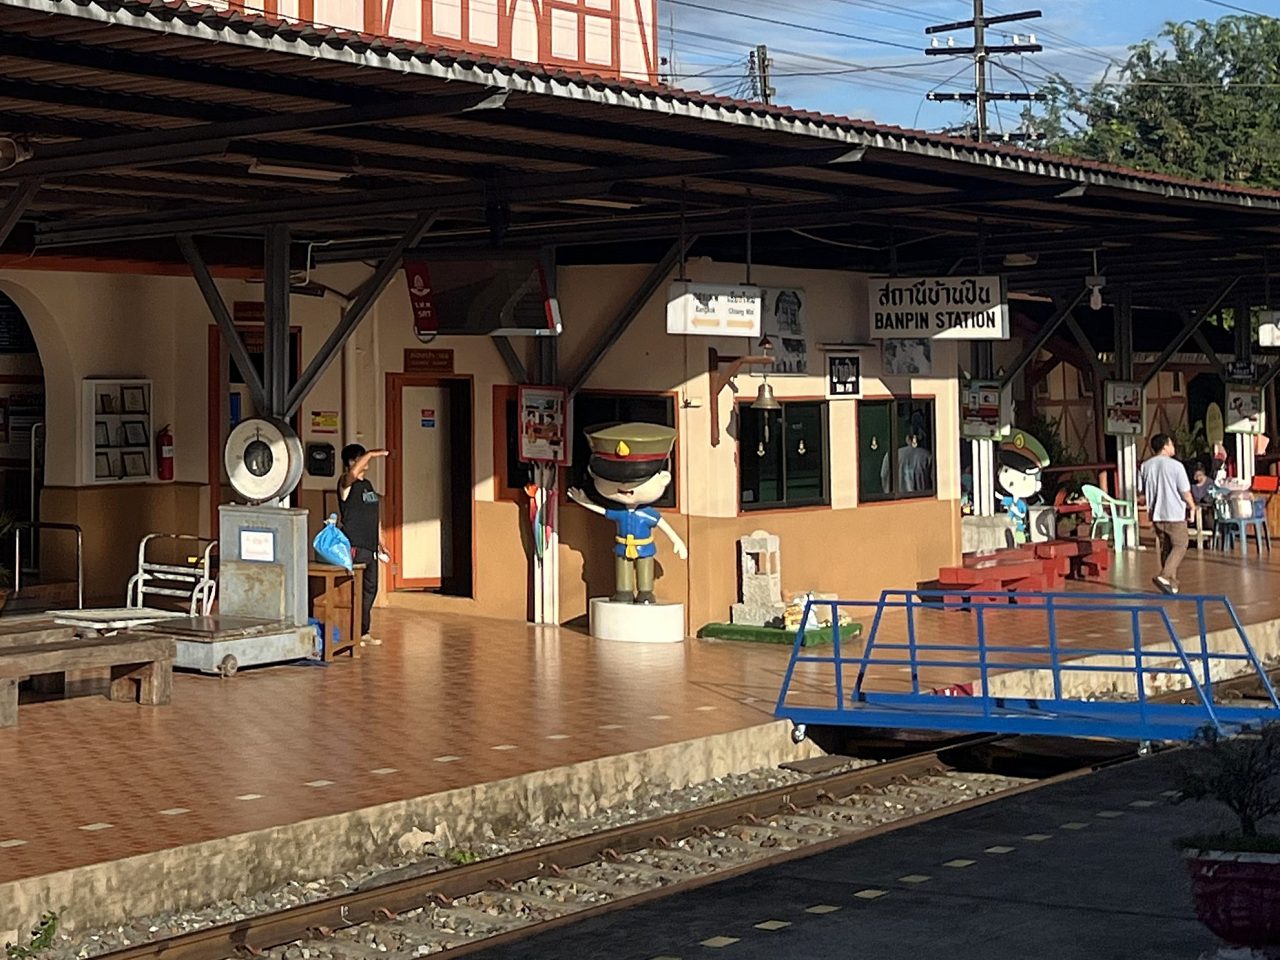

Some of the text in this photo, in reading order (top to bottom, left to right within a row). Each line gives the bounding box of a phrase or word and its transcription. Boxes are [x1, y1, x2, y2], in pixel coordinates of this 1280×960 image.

[878, 278, 991, 307] สถานีบ้านปิน
[417, 310, 432, 318] SRT
[874, 310, 995, 329] BANPIN STATION
